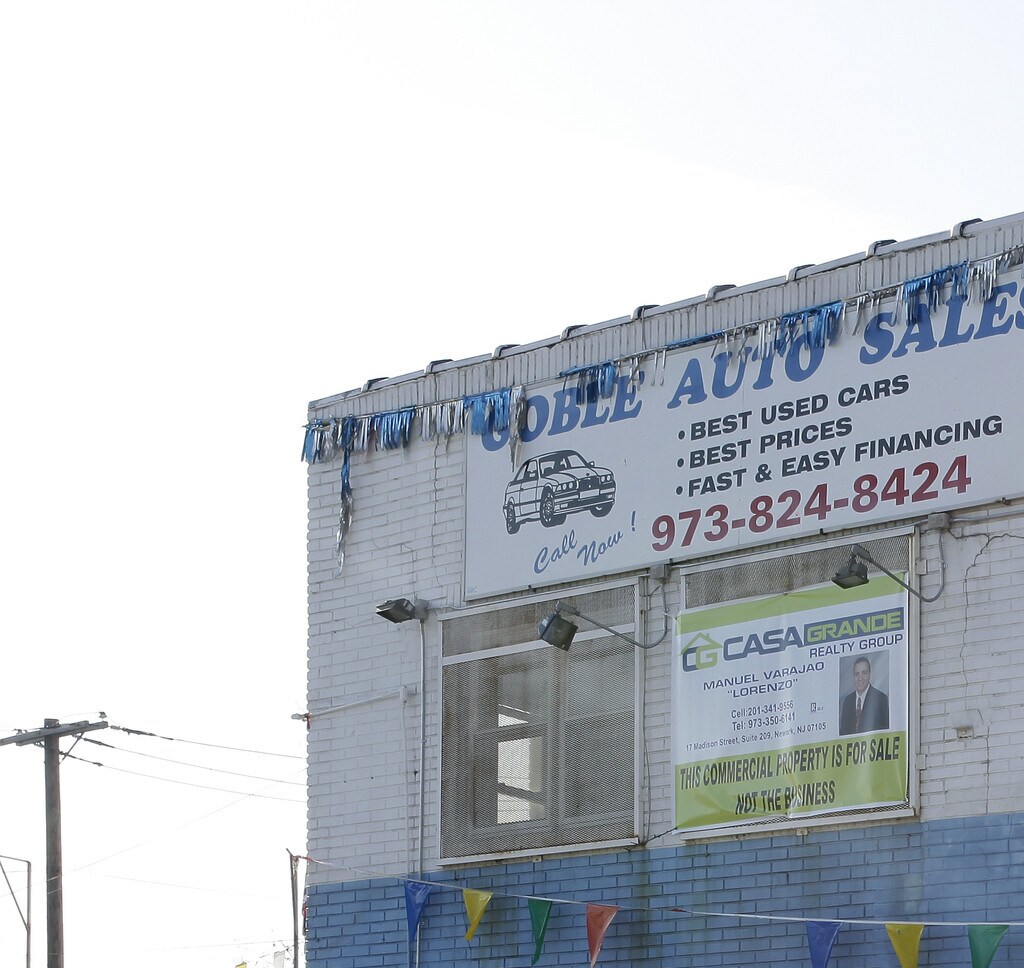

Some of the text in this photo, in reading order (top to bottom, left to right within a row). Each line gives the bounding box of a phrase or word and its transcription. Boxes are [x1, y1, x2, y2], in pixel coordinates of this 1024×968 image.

[667, 334, 825, 408] AUTO
[690, 374, 909, 441] BEST USED CARS
[688, 415, 1003, 498] FAST & EASY FINANCING
[689, 416, 852, 469] BEST PRICES
[651, 454, 972, 552] 973-824-8424
[534, 529, 577, 574] Call
[577, 530, 623, 567] Now
[723, 611, 901, 662] CASA GRANDE
[809, 633, 904, 659] REALTY GROUP
[703, 661, 825, 691] MANUEL VARAJAO
[693, 740, 718, 751] Madison
[741, 734, 757, 743] Suite
[797, 725, 806, 733] NJ
[807, 722, 827, 732] 07105
[732, 721, 746, 731] Tel:
[680, 736, 900, 790] THIS COMMERCIAL PROPERTY IS FOR SALE
[735, 780, 836, 815] NOT THE BUSINESS
